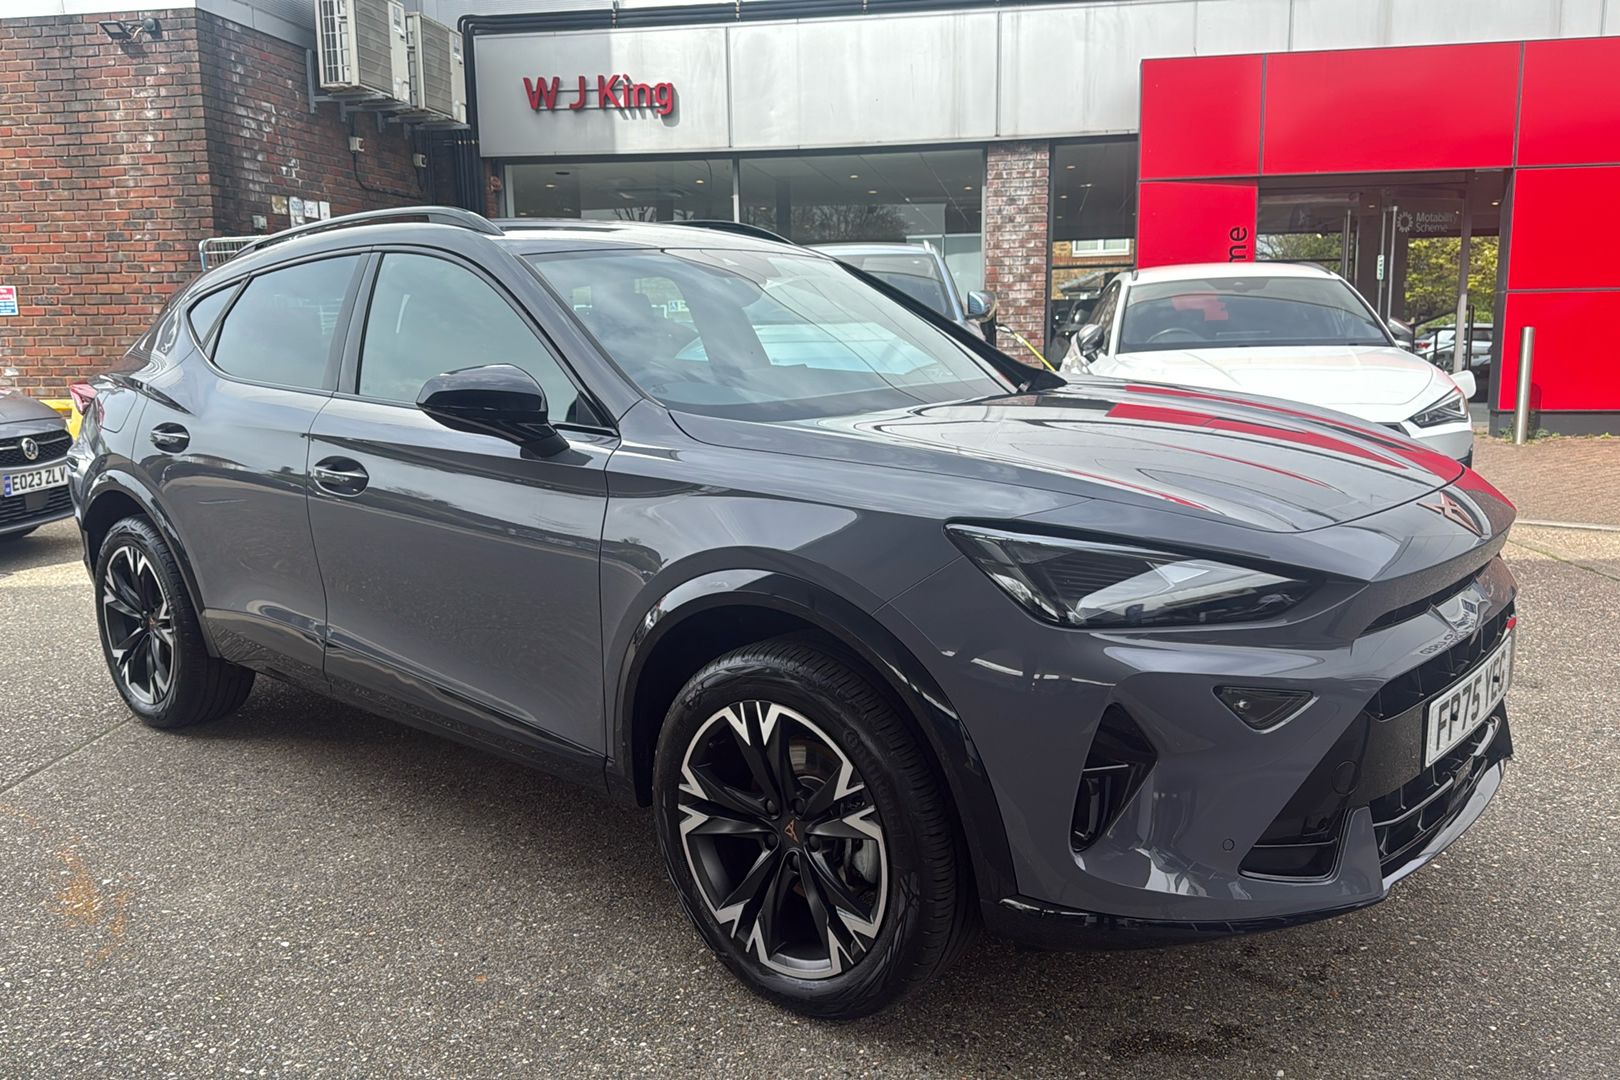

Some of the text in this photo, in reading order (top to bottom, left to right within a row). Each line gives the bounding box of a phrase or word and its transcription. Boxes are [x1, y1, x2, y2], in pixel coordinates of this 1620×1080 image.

[523, 73, 674, 115] W J King
[45, 466, 66, 485] ZLV
[1436, 673, 1483, 751] FP75
